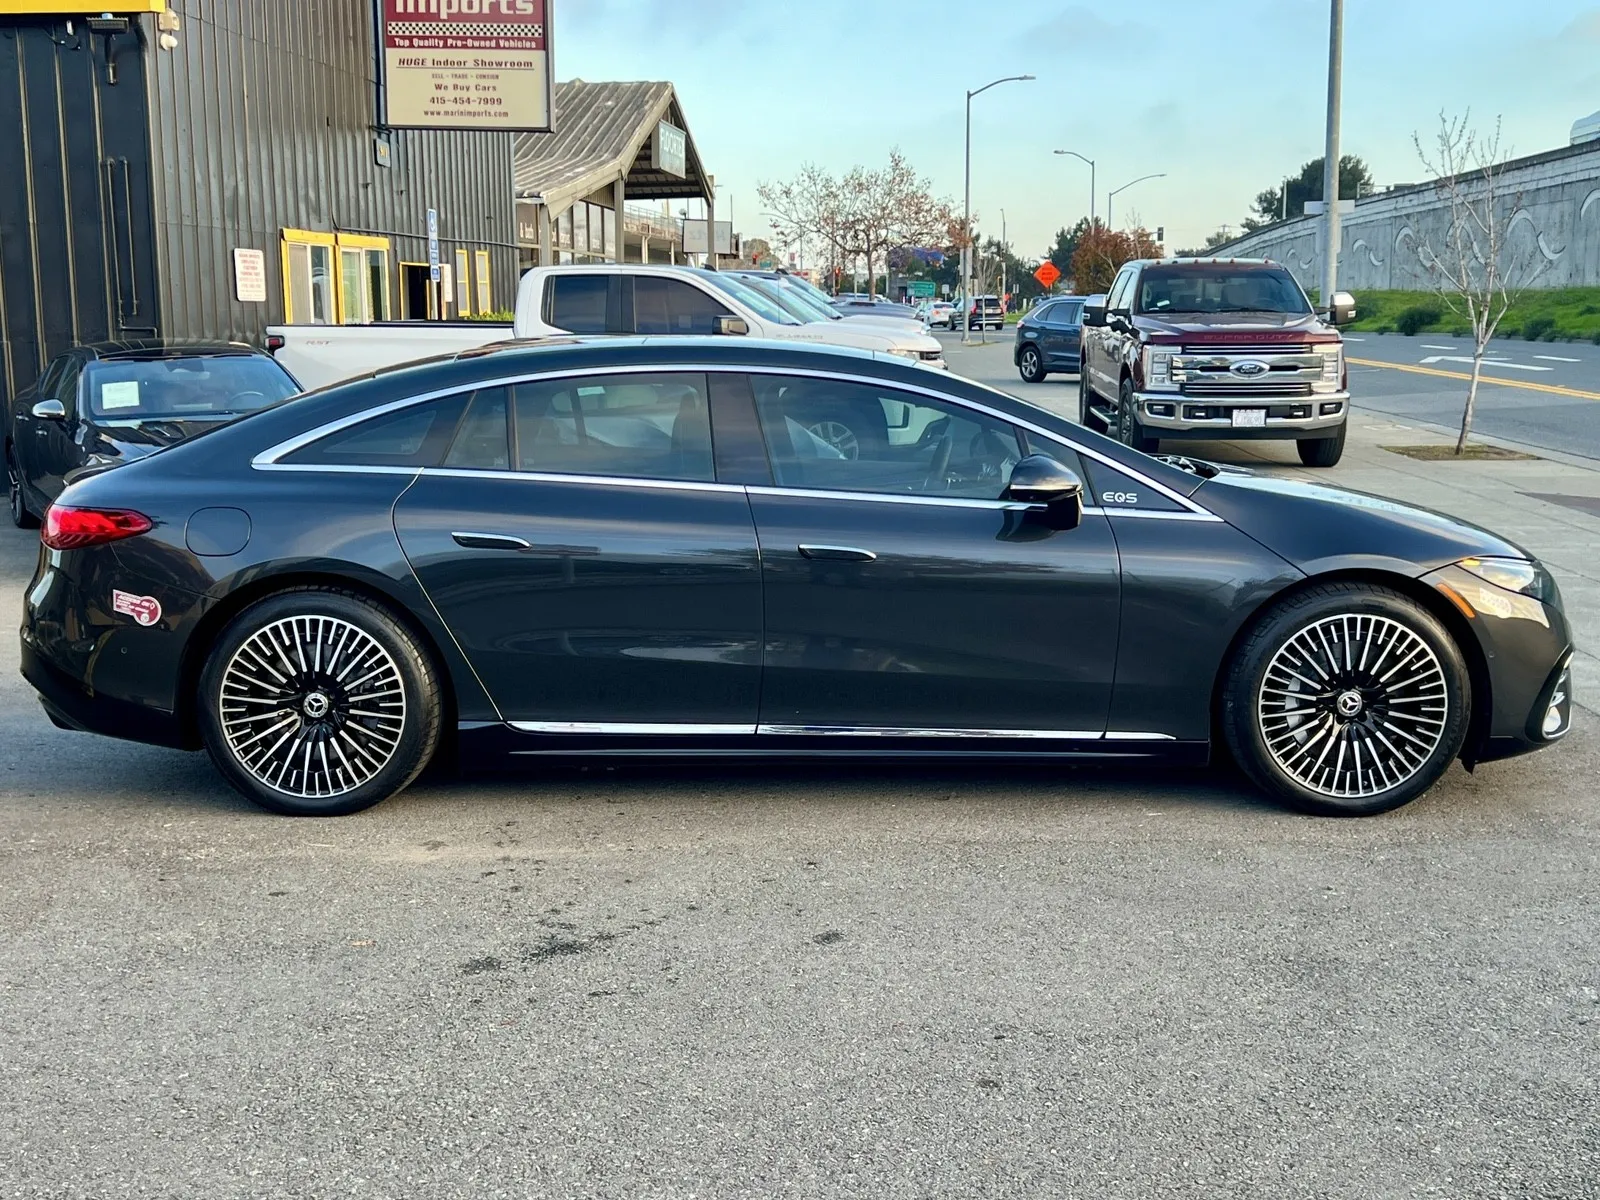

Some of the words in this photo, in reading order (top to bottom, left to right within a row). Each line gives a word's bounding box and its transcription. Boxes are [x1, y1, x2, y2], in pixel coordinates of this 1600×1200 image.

[394, 38, 410, 47] Top
[412, 38, 444, 47] Quality
[447, 38, 496, 48] Pre-Owned
[499, 39, 537, 48] Vehicles
[398, 58, 427, 66] HUGE
[432, 58, 468, 67] Indoor
[473, 59, 533, 68] Showroom
[434, 83, 448, 91] We
[453, 83, 470, 92] Buy
[475, 84, 497, 92] Cars
[430, 96, 502, 105] 415-454-7999
[423, 109, 509, 118] www.marinimports.com
[1240, 364, 1260, 373] Ford
[1102, 492, 1138, 504] EQS
